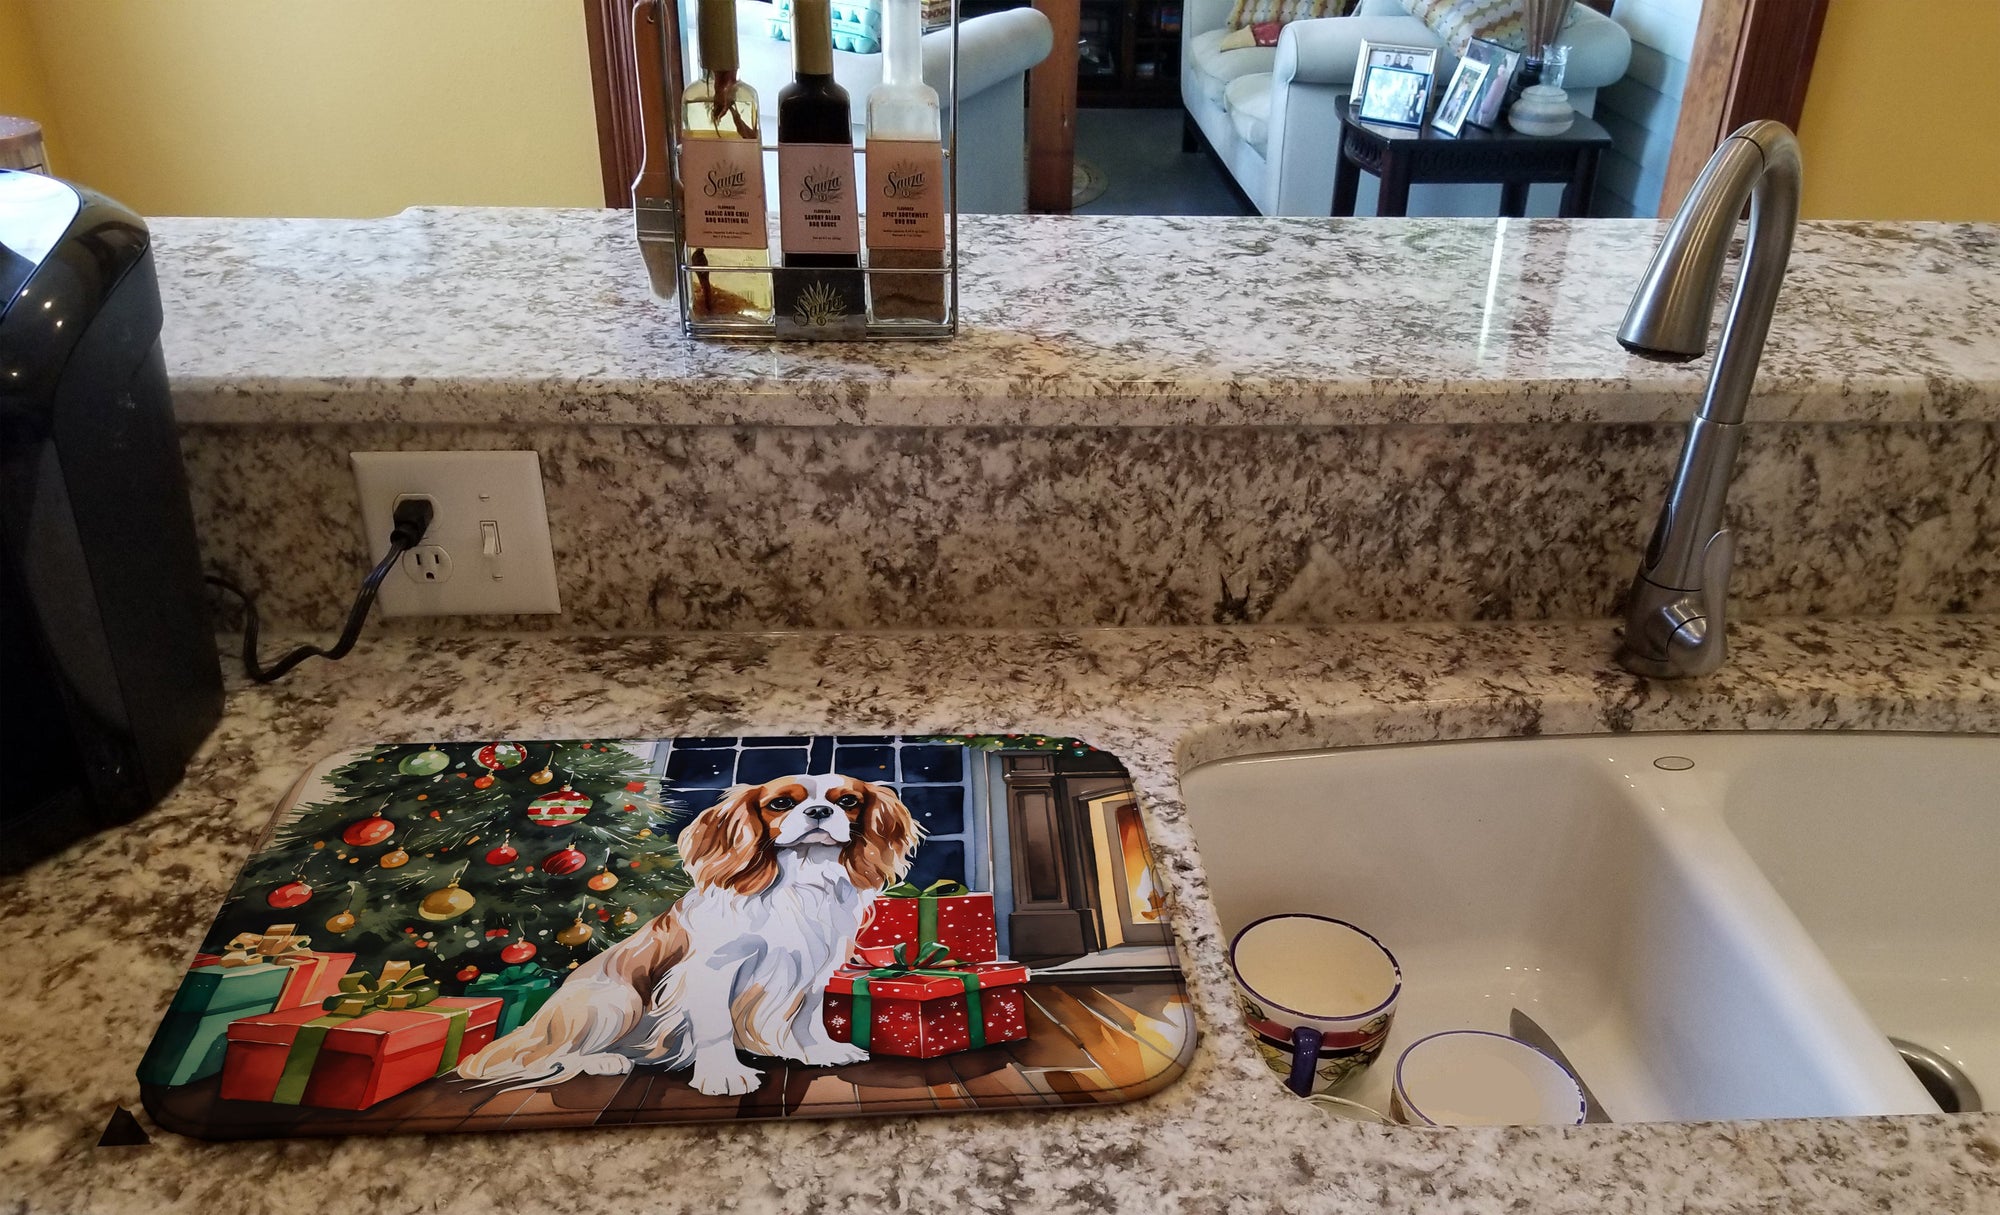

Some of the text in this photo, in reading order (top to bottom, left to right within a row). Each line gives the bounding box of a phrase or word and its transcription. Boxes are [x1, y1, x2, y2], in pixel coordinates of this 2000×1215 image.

[703, 170, 745, 197] Sauza
[800, 175, 841, 202] Sauza
[883, 171, 925, 198] Sauza
